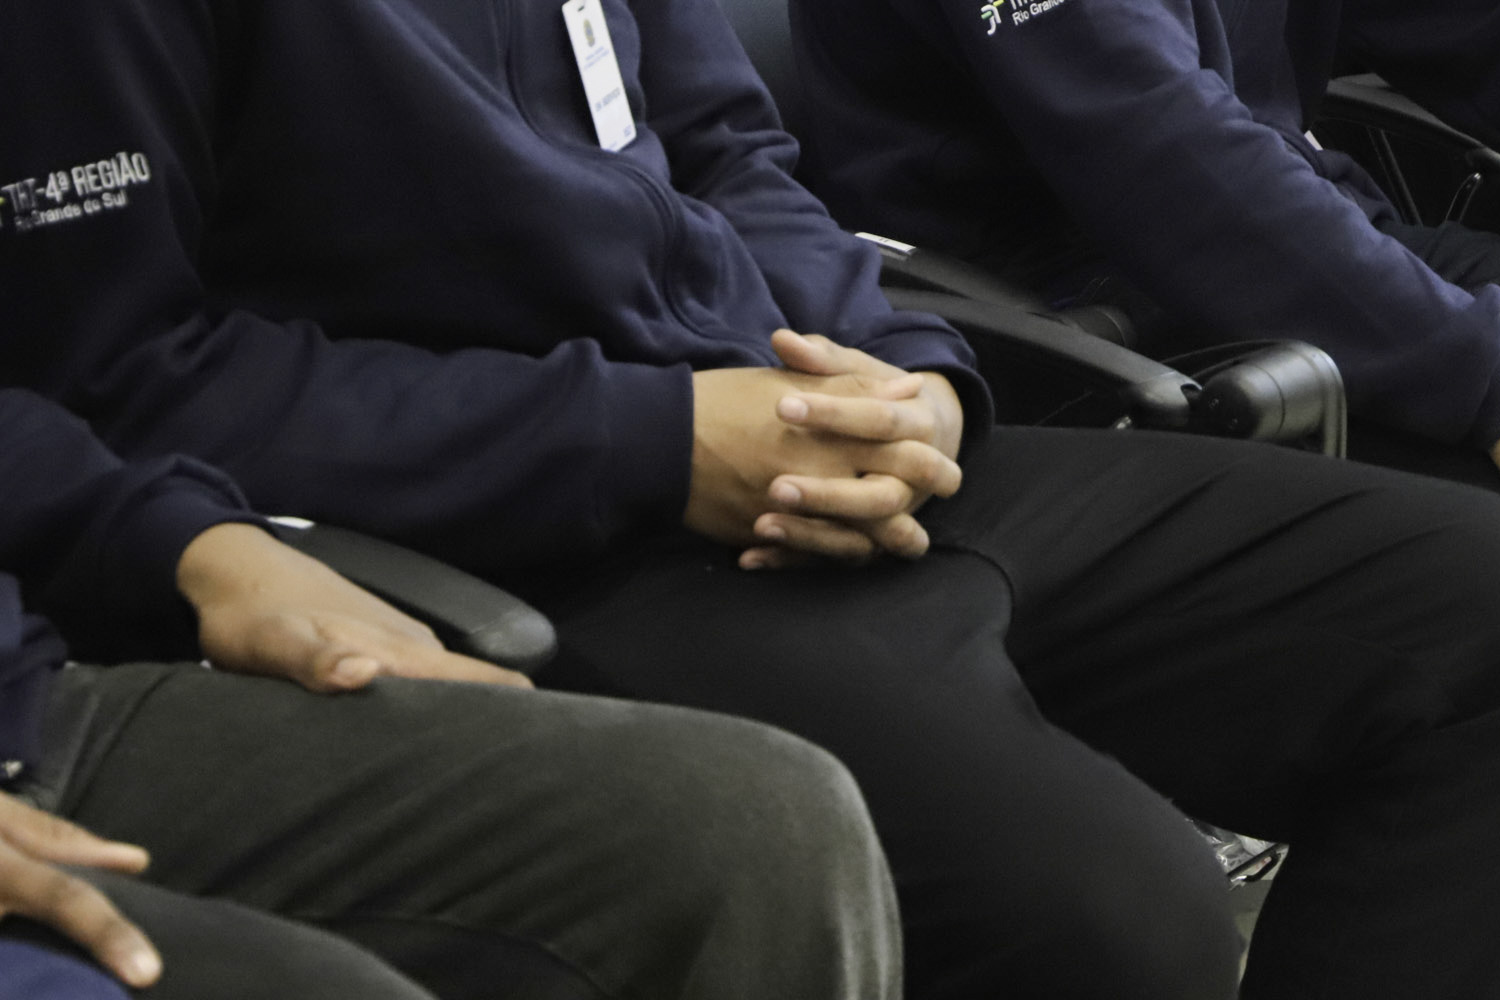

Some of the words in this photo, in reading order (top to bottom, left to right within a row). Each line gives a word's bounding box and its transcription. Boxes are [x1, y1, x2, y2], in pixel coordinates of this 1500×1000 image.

[1012, 10, 1030, 26] Rio
[71, 151, 150, 197] REGIÃO
[83, 199, 101, 214] do
[101, 189, 128, 208] Sul
